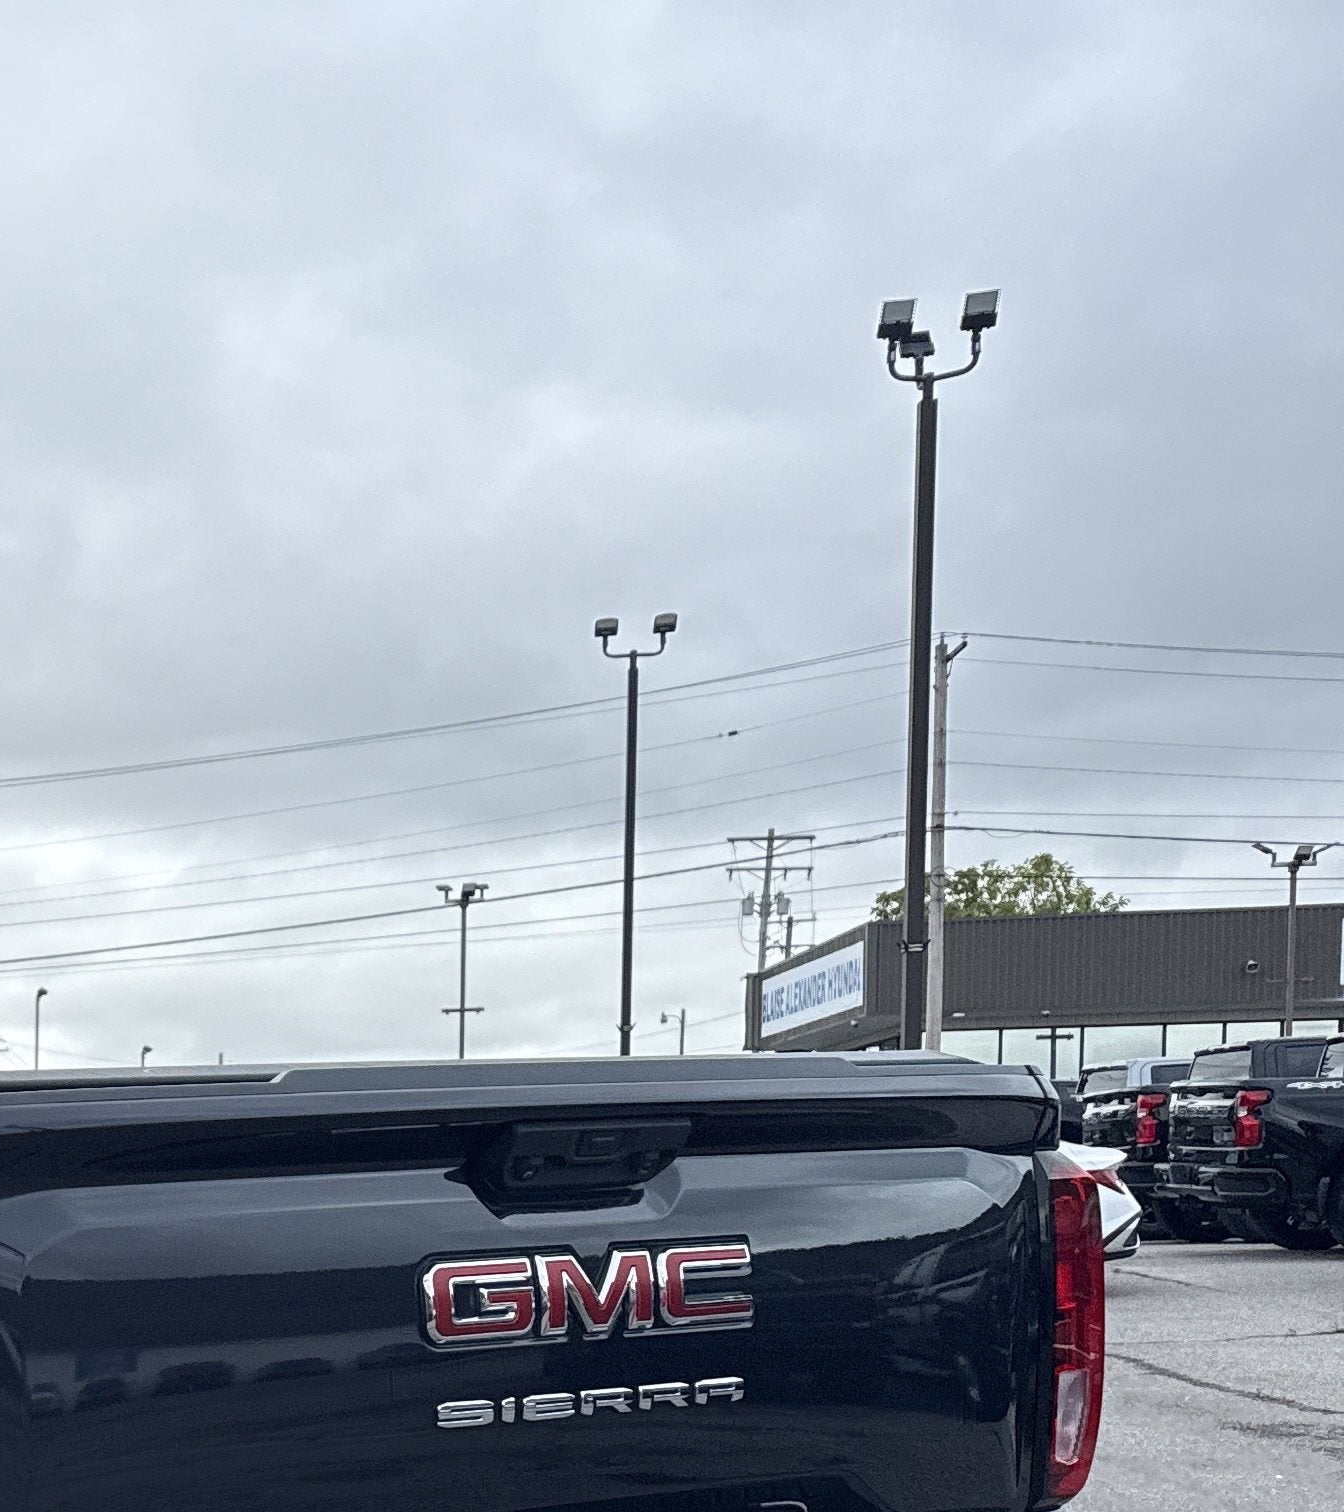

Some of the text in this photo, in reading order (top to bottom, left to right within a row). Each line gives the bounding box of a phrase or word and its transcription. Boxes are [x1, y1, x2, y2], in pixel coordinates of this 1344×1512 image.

[786, 971, 826, 1016] ALEXANDER
[828, 958, 860, 1001] HYUNDAI
[423, 1242, 754, 1345] GMC
[437, 1376, 745, 1429] SIERRA
